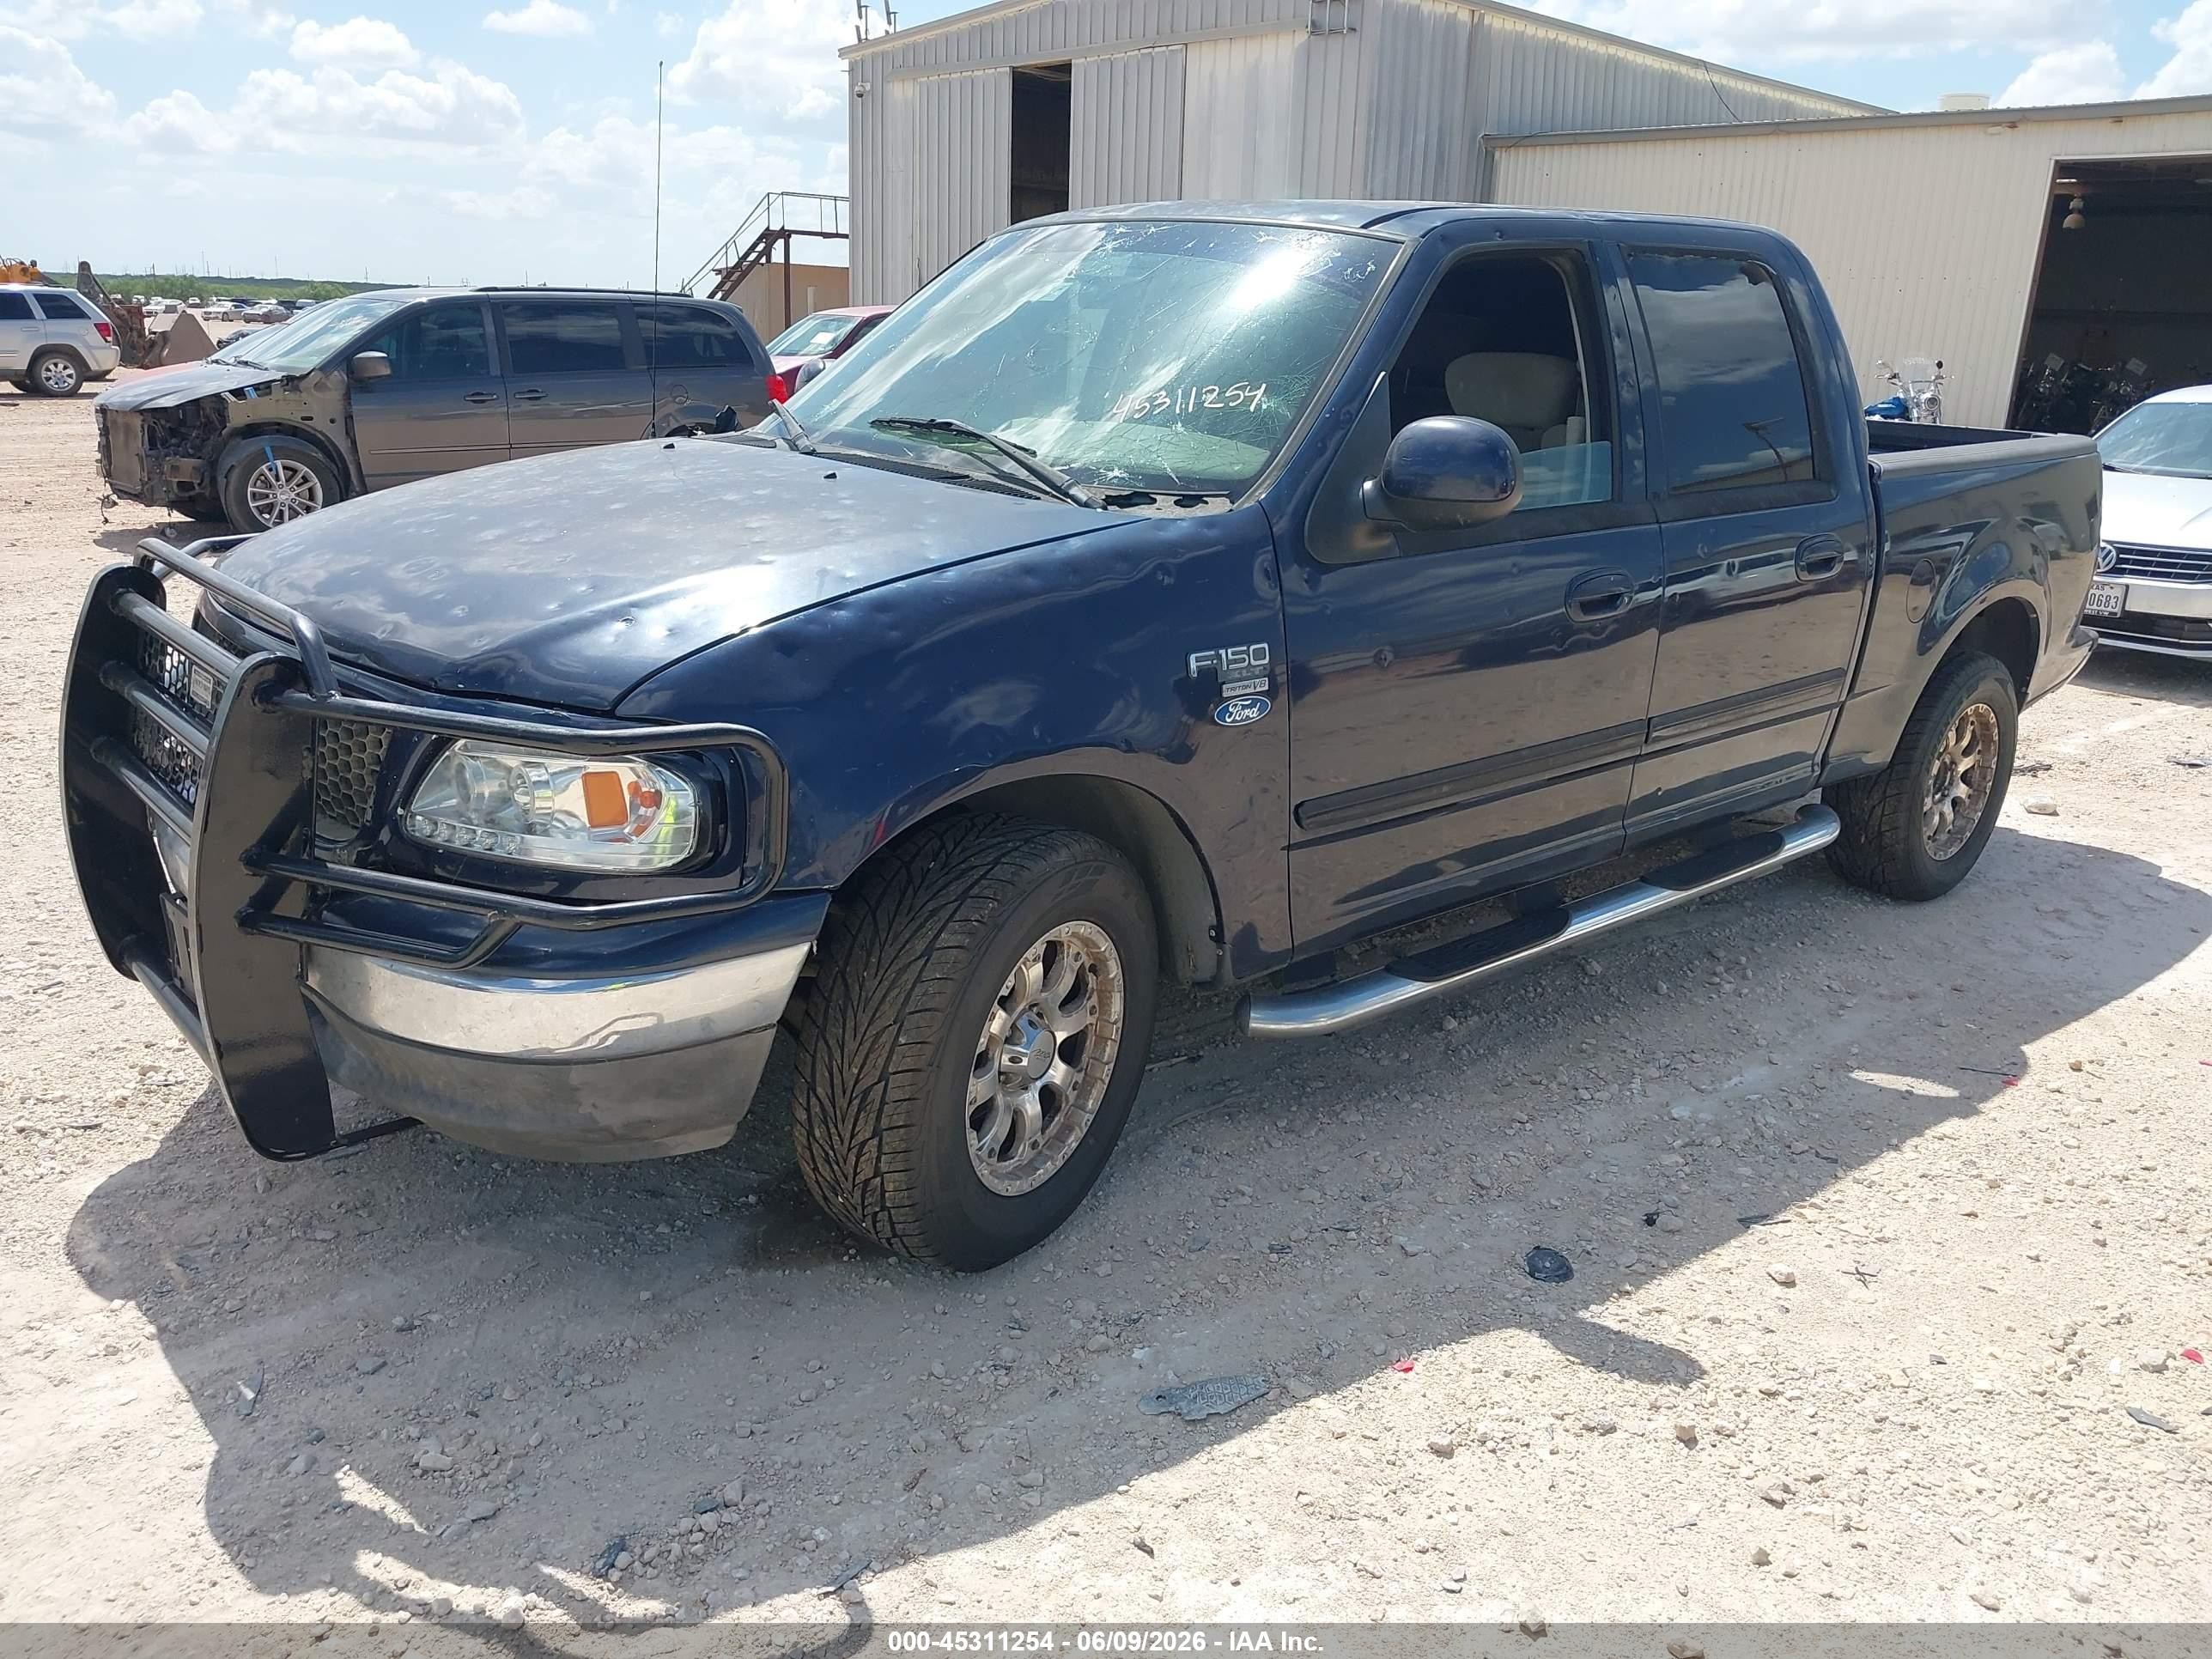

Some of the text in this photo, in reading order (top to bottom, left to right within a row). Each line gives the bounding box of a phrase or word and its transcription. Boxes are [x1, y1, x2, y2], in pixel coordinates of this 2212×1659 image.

[1112, 382, 1267, 423] 45311254
[2088, 592, 2119, 610] 0683
[1189, 642, 1270, 678] F-150
[1225, 679, 1267, 693] TRITON V8
[1225, 700, 1261, 722] Ford
